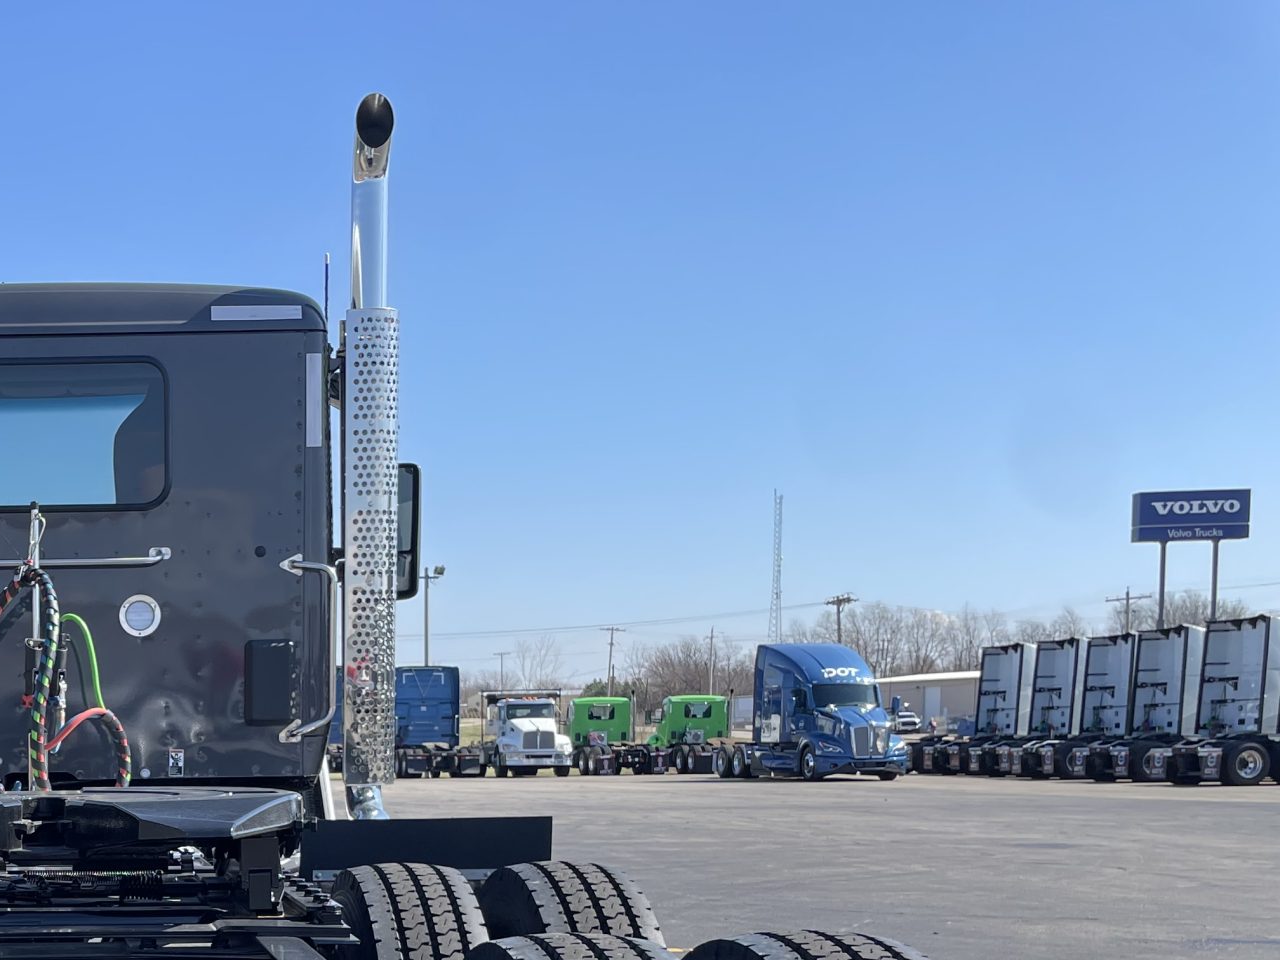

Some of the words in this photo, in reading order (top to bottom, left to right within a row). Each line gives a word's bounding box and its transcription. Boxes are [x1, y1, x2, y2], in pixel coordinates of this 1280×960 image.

[1151, 499, 1241, 515] VOLVO
[1167, 529, 1192, 538] Volvo
[1194, 527, 1223, 538] Trucks
[821, 667, 859, 678] DOT
